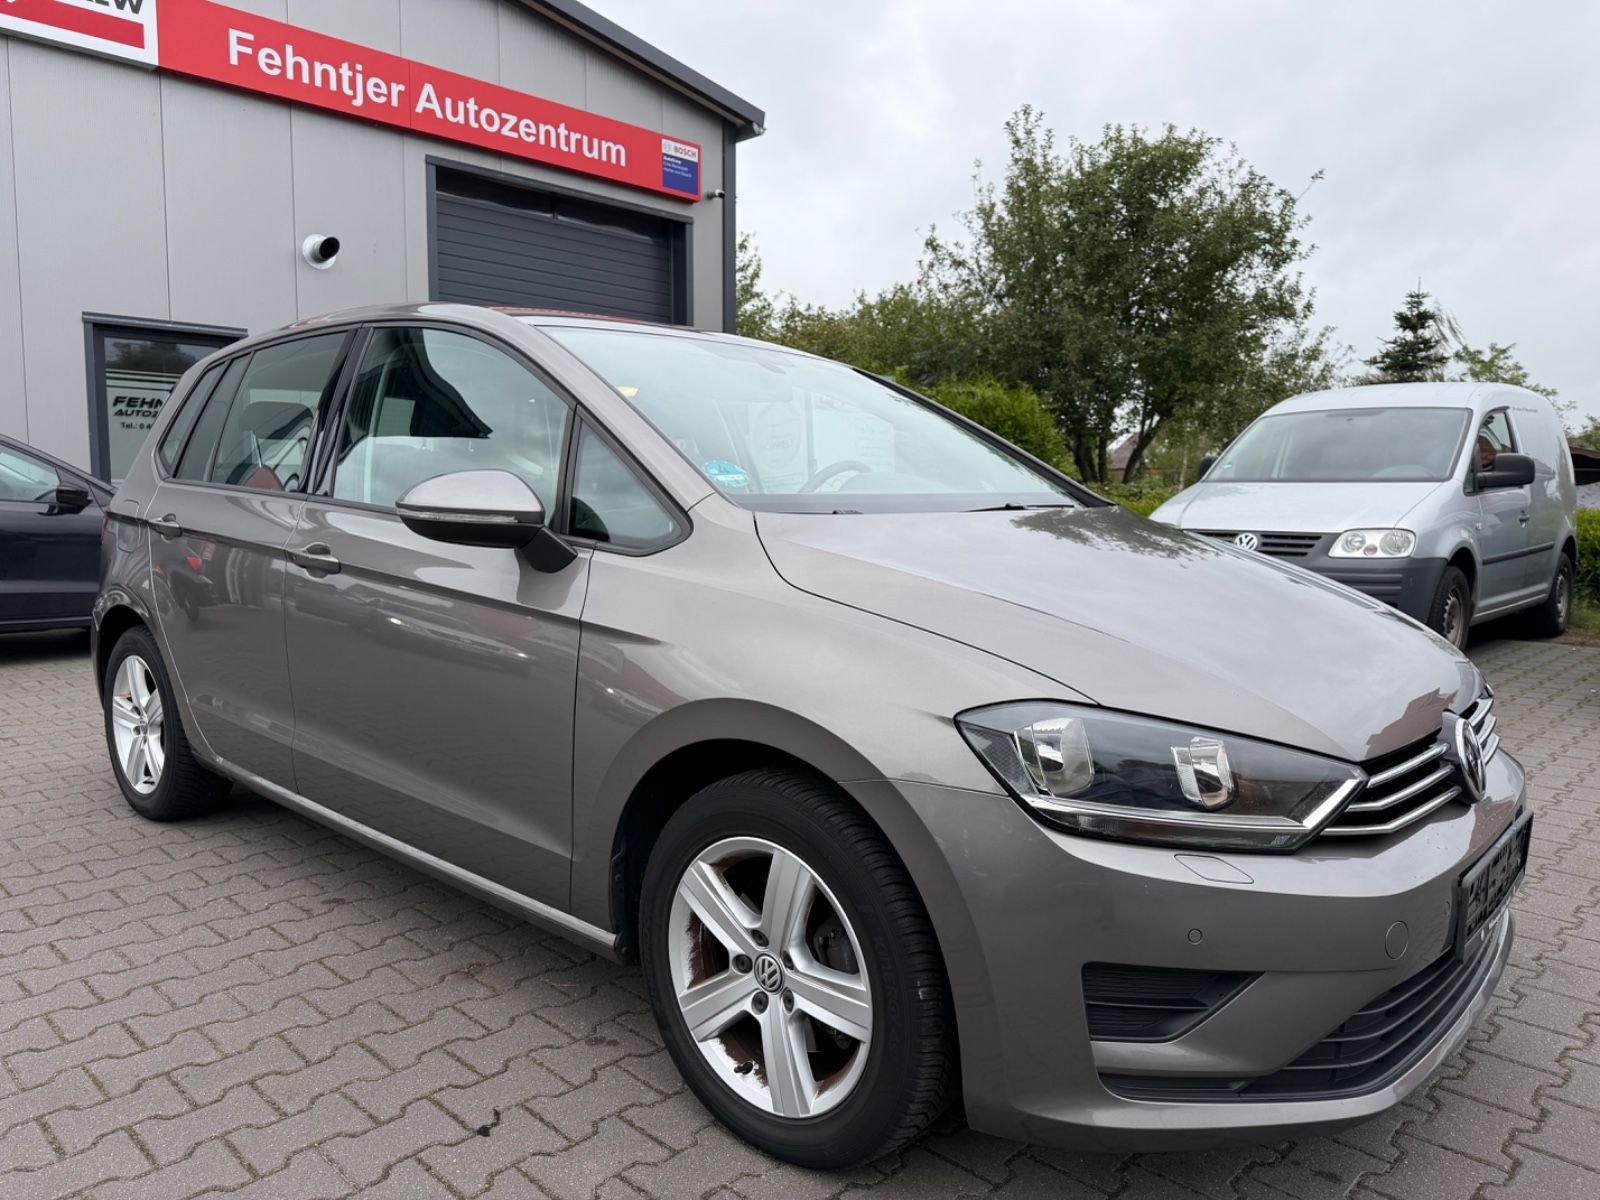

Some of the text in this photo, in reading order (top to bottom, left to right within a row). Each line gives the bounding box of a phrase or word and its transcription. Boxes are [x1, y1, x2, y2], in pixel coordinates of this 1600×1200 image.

[228, 28, 626, 167] Fehntjer Autozentrum
[673, 145, 697, 158] BOSCH
